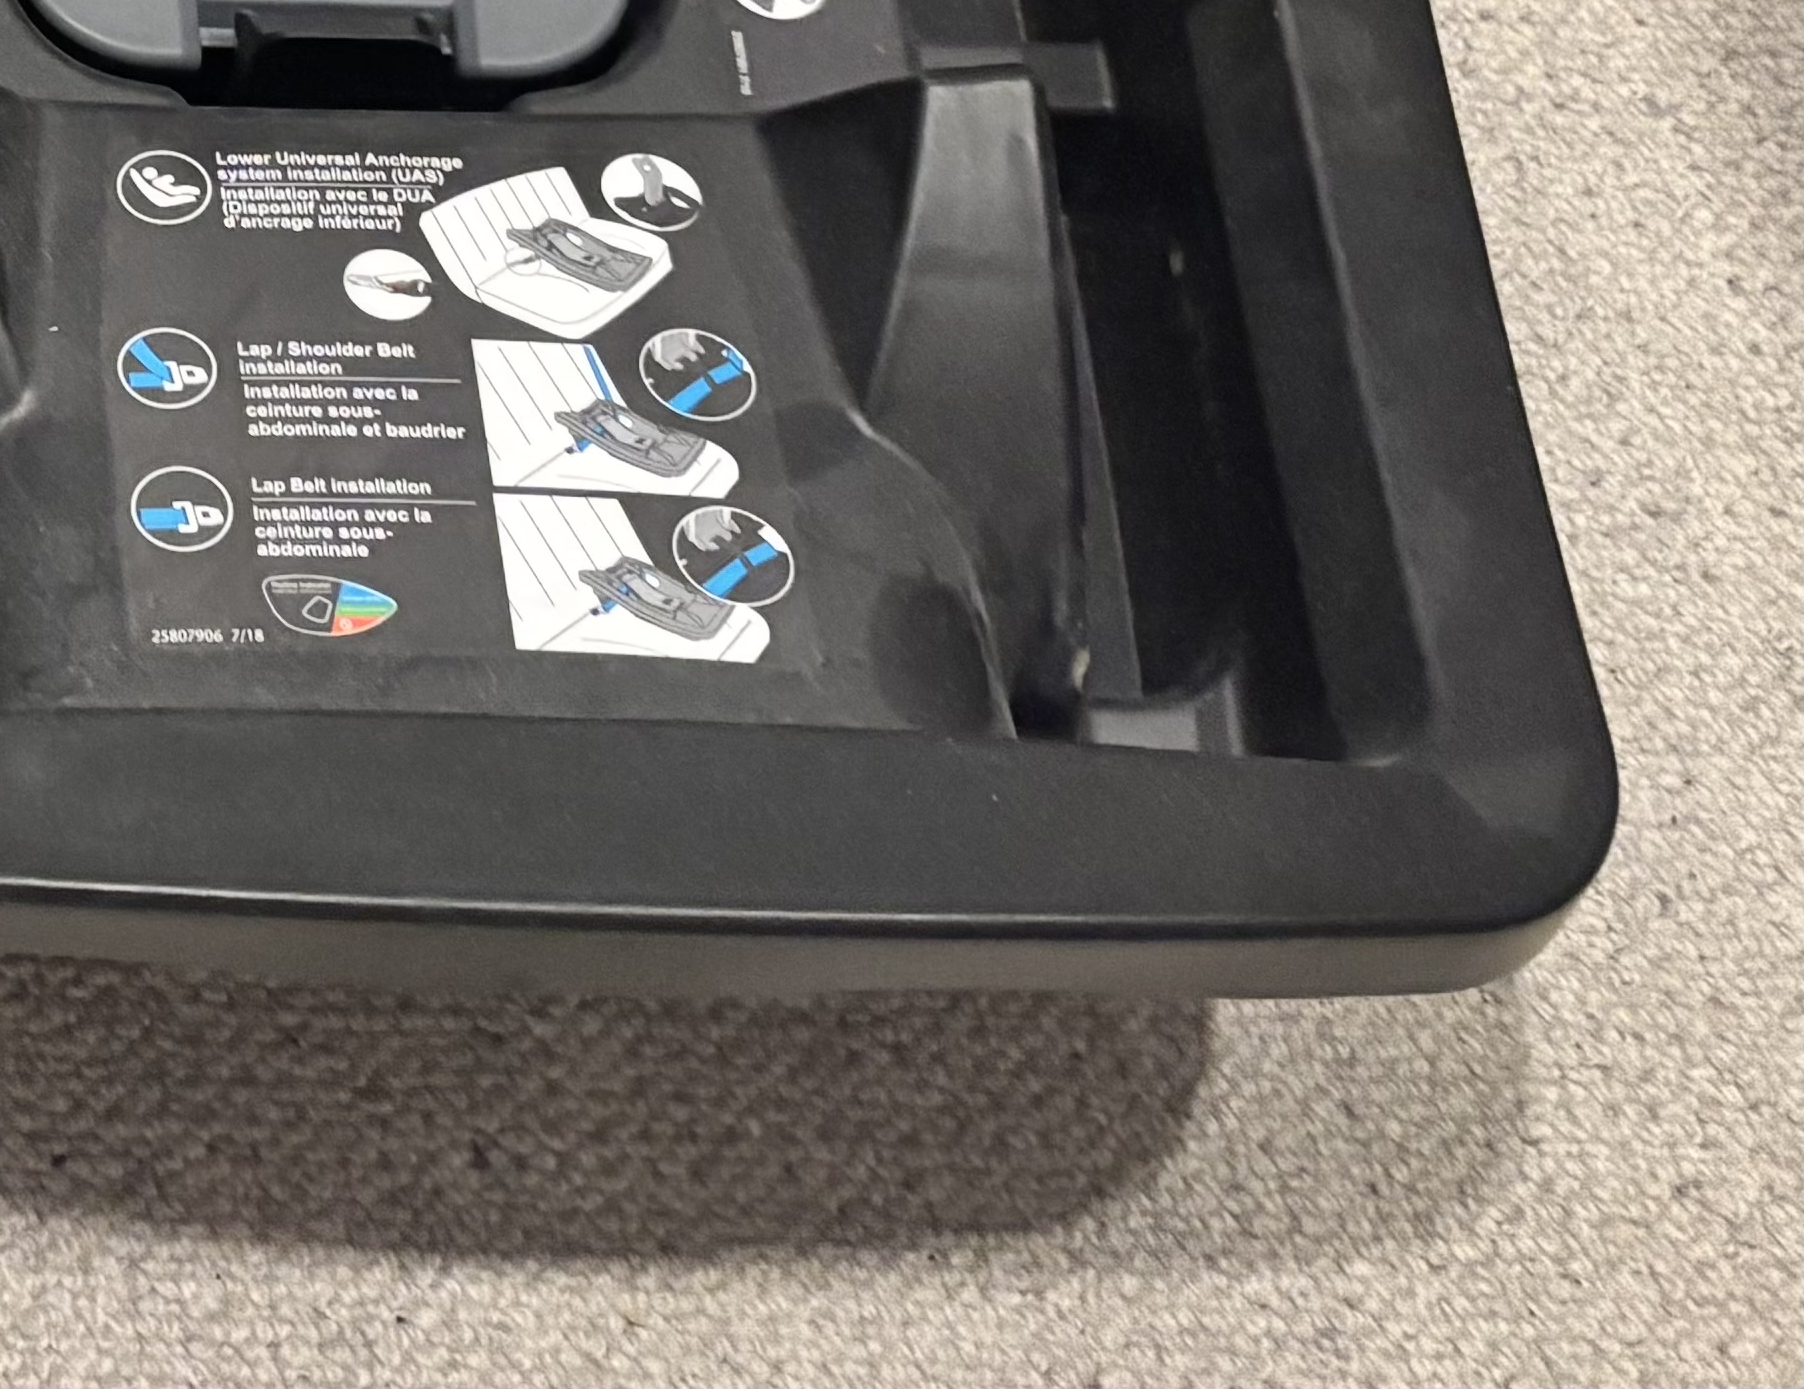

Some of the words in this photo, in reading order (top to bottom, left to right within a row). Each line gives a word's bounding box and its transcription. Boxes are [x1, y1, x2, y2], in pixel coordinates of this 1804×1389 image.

[216, 151, 272, 166] Lower
[276, 151, 361, 166] Universal
[365, 152, 463, 172] Anchorage
[217, 167, 282, 183] system
[392, 168, 444, 186] (UAS)
[325, 189, 367, 202] avec
[373, 187, 389, 202] le
[394, 188, 436, 204] DUA
[223, 215, 313, 232] d'ancrage
[237, 341, 273, 360] Lap
[288, 341, 373, 357] Shoulder
[377, 342, 416, 358] Belt
[352, 386, 397, 400] avec
[401, 385, 419, 401] la
[246, 402, 323, 418] ceinture
[327, 405, 381, 418] sous-
[248, 421, 358, 437] abdominale
[362, 421, 381, 437] et
[385, 421, 466, 439] baudrier
[251, 477, 286, 496] Lap
[290, 477, 328, 494] Belt
[364, 509, 409, 523] avec
[414, 507, 432, 523] la
[255, 523, 333, 539] ceinture
[338, 526, 394, 539] sous-
[257, 541, 370, 557] abdominale
[151, 629, 224, 644] 25807906
[231, 628, 264, 643] 7/18
